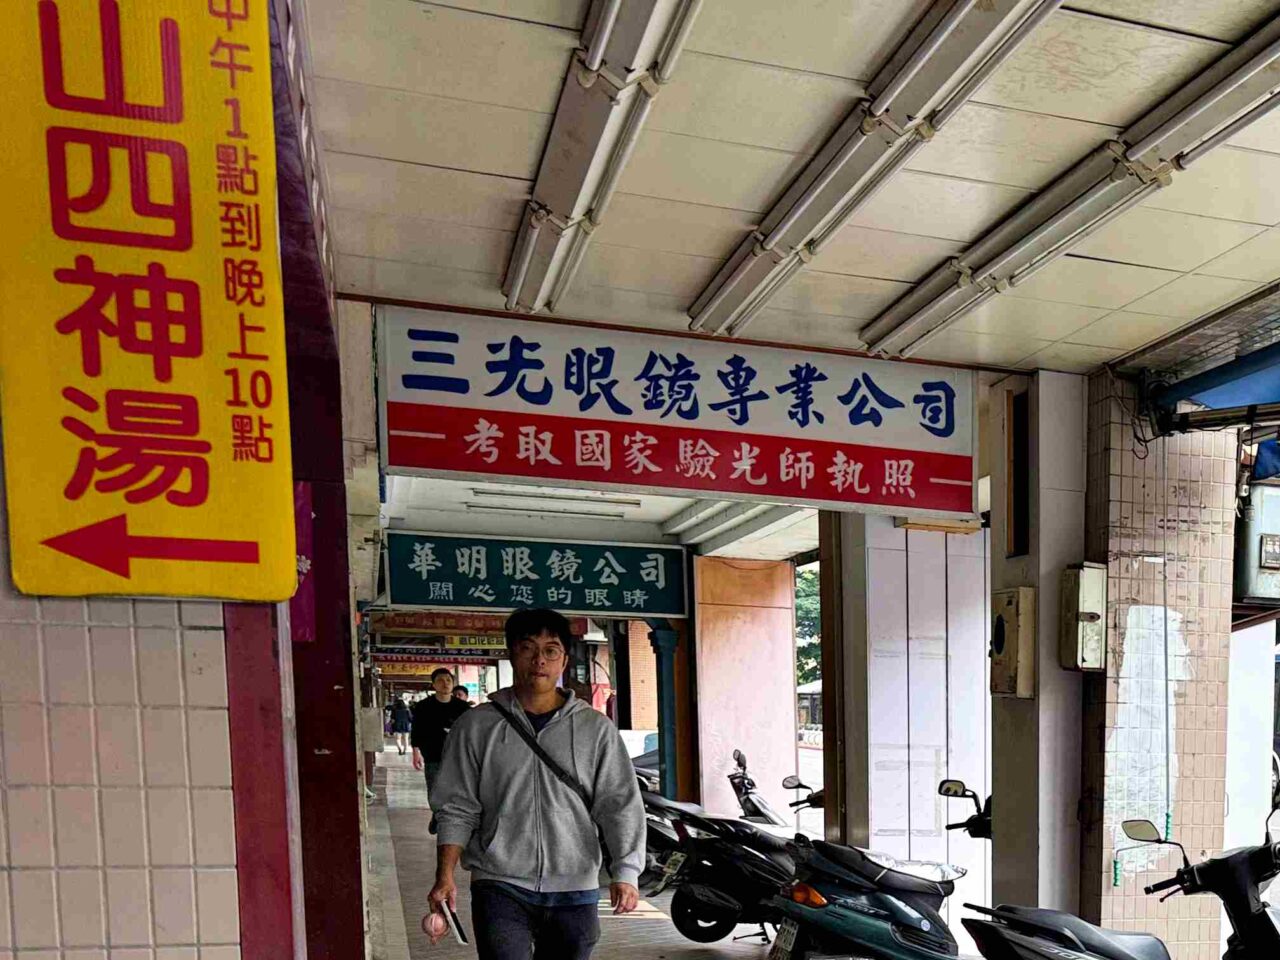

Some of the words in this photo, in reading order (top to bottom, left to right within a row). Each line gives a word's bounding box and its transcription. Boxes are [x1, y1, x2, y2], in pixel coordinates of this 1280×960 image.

[401, 327, 958, 439] 三光眼鏡專業公司
[462, 417, 918, 500] 考取國家驗光師執照
[407, 540, 669, 590] 華明眼鏡公司
